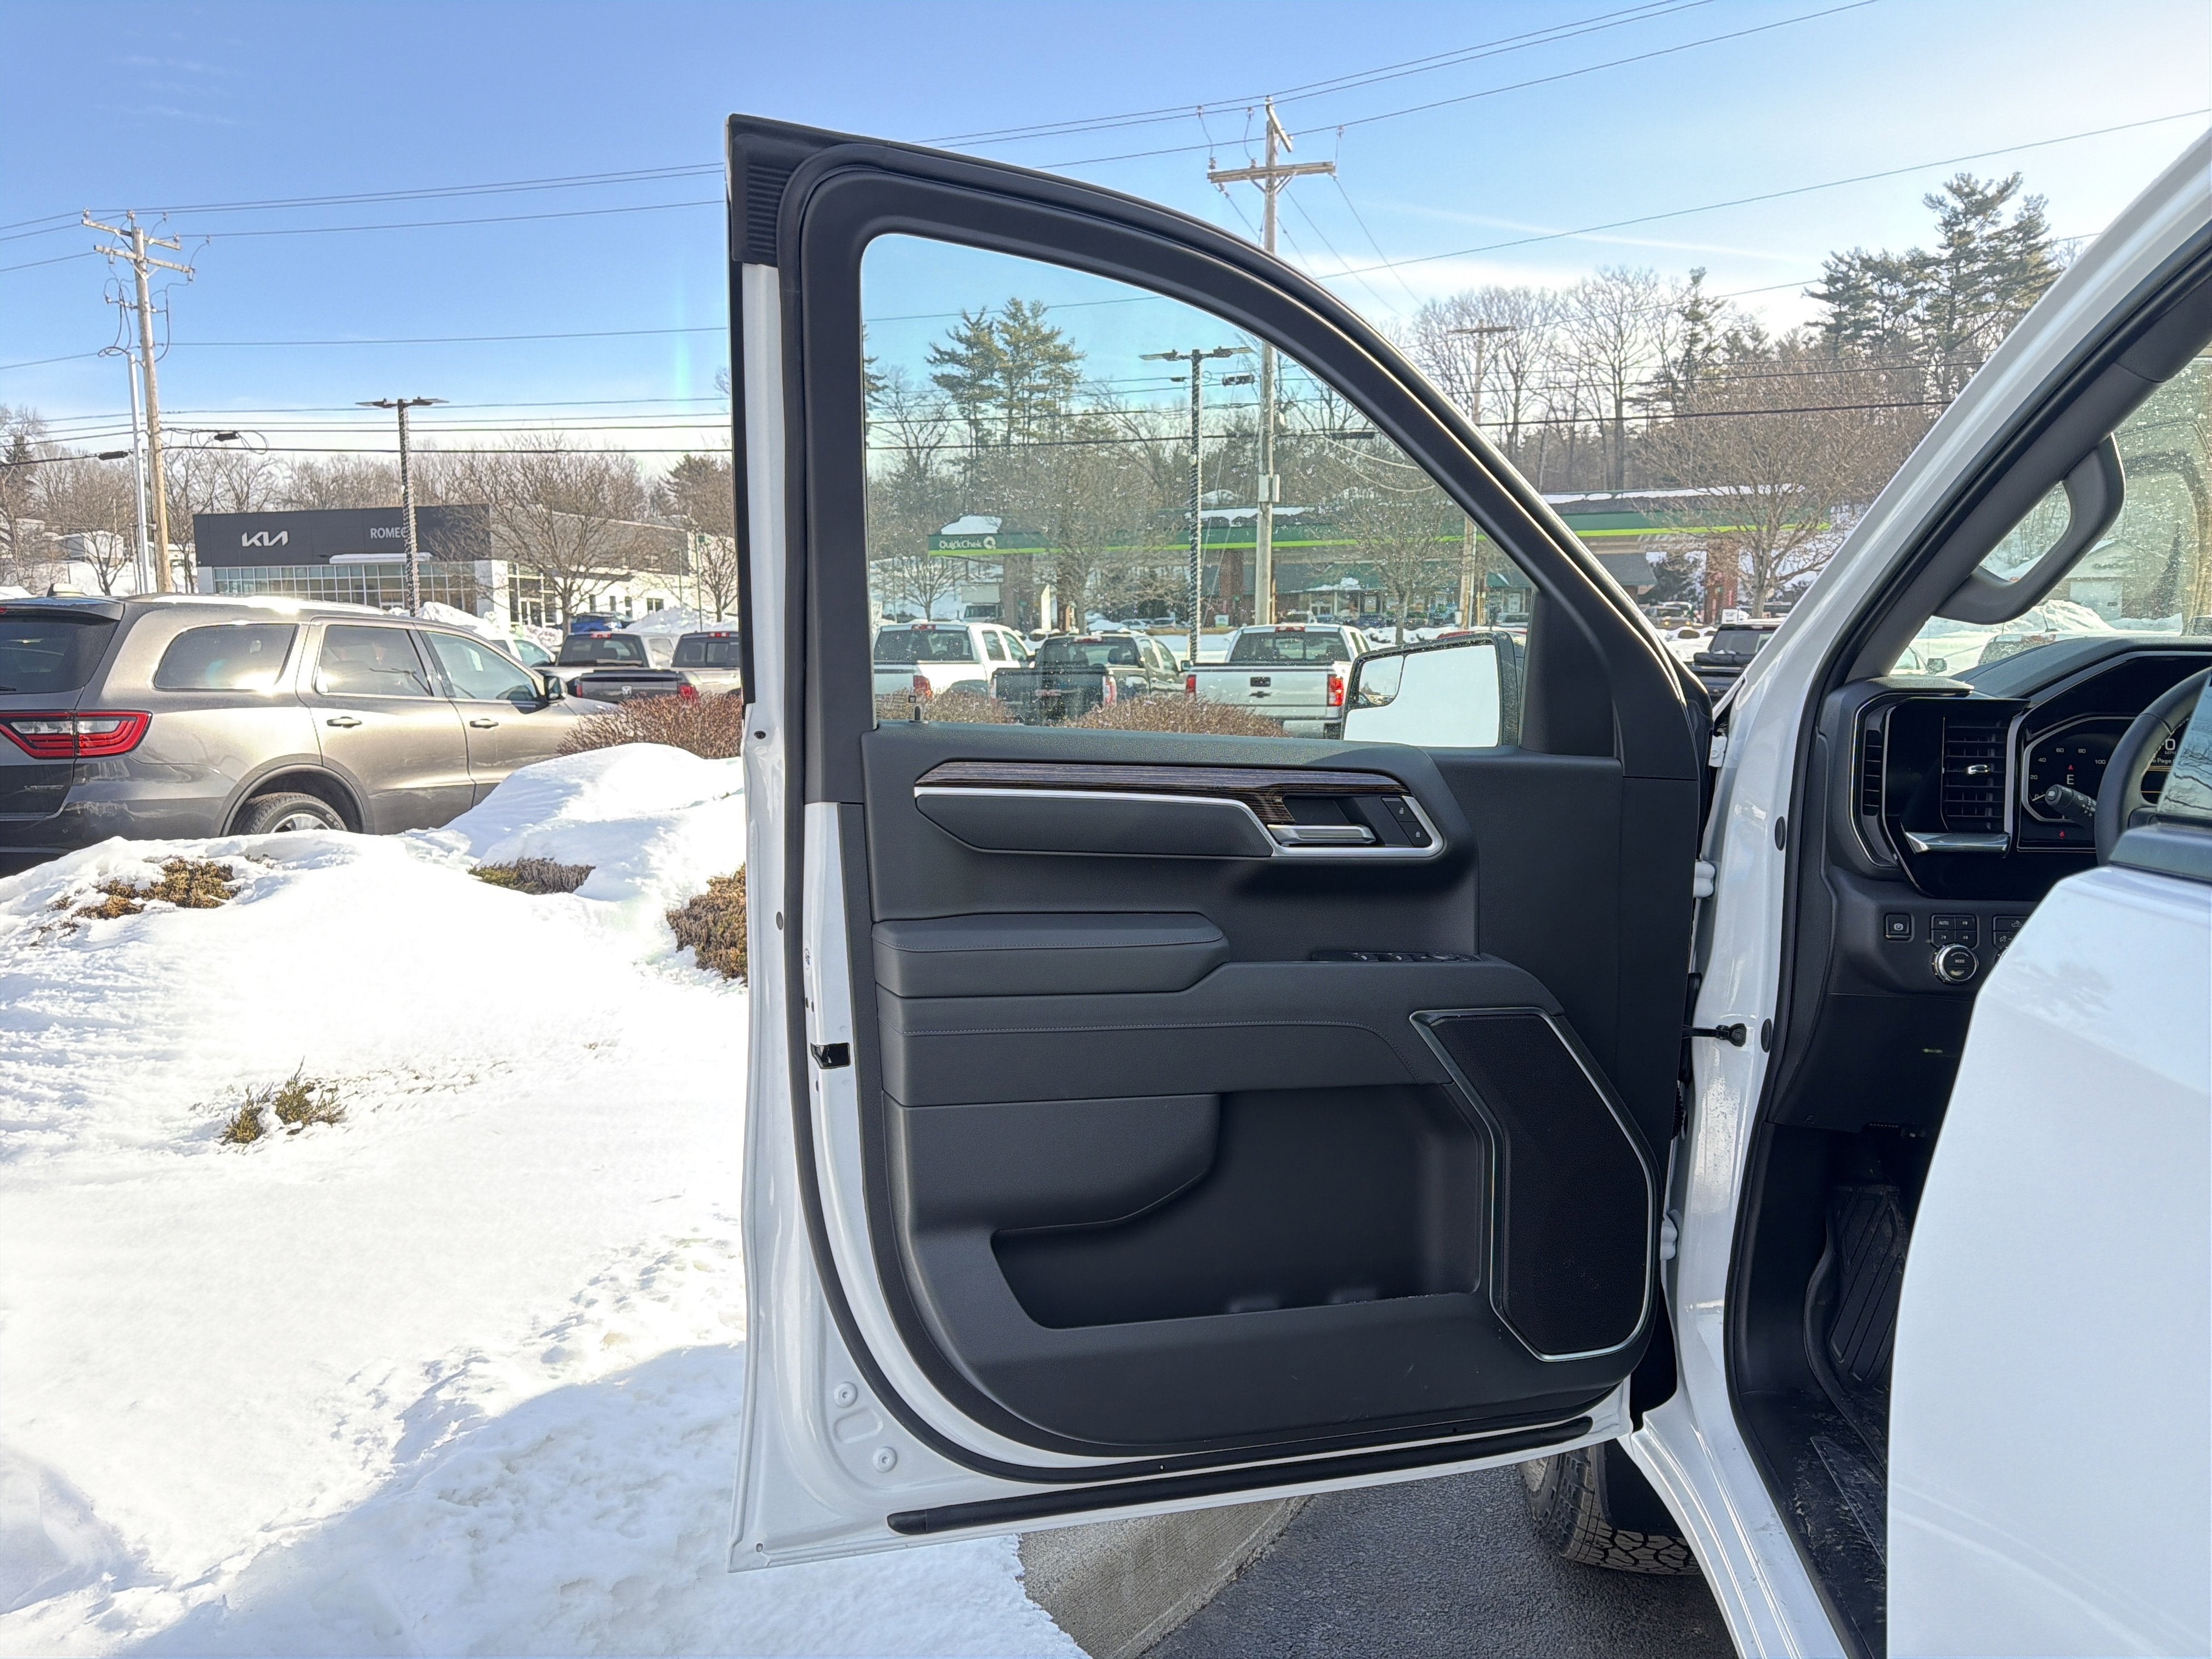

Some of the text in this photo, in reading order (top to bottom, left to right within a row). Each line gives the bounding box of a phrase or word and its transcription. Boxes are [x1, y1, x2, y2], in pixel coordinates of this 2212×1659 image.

[241, 531, 289, 547] KIA
[939, 539, 983, 550] QuickChek
[2165, 738, 2176, 751] 0
[2067, 774, 2075, 785] E
